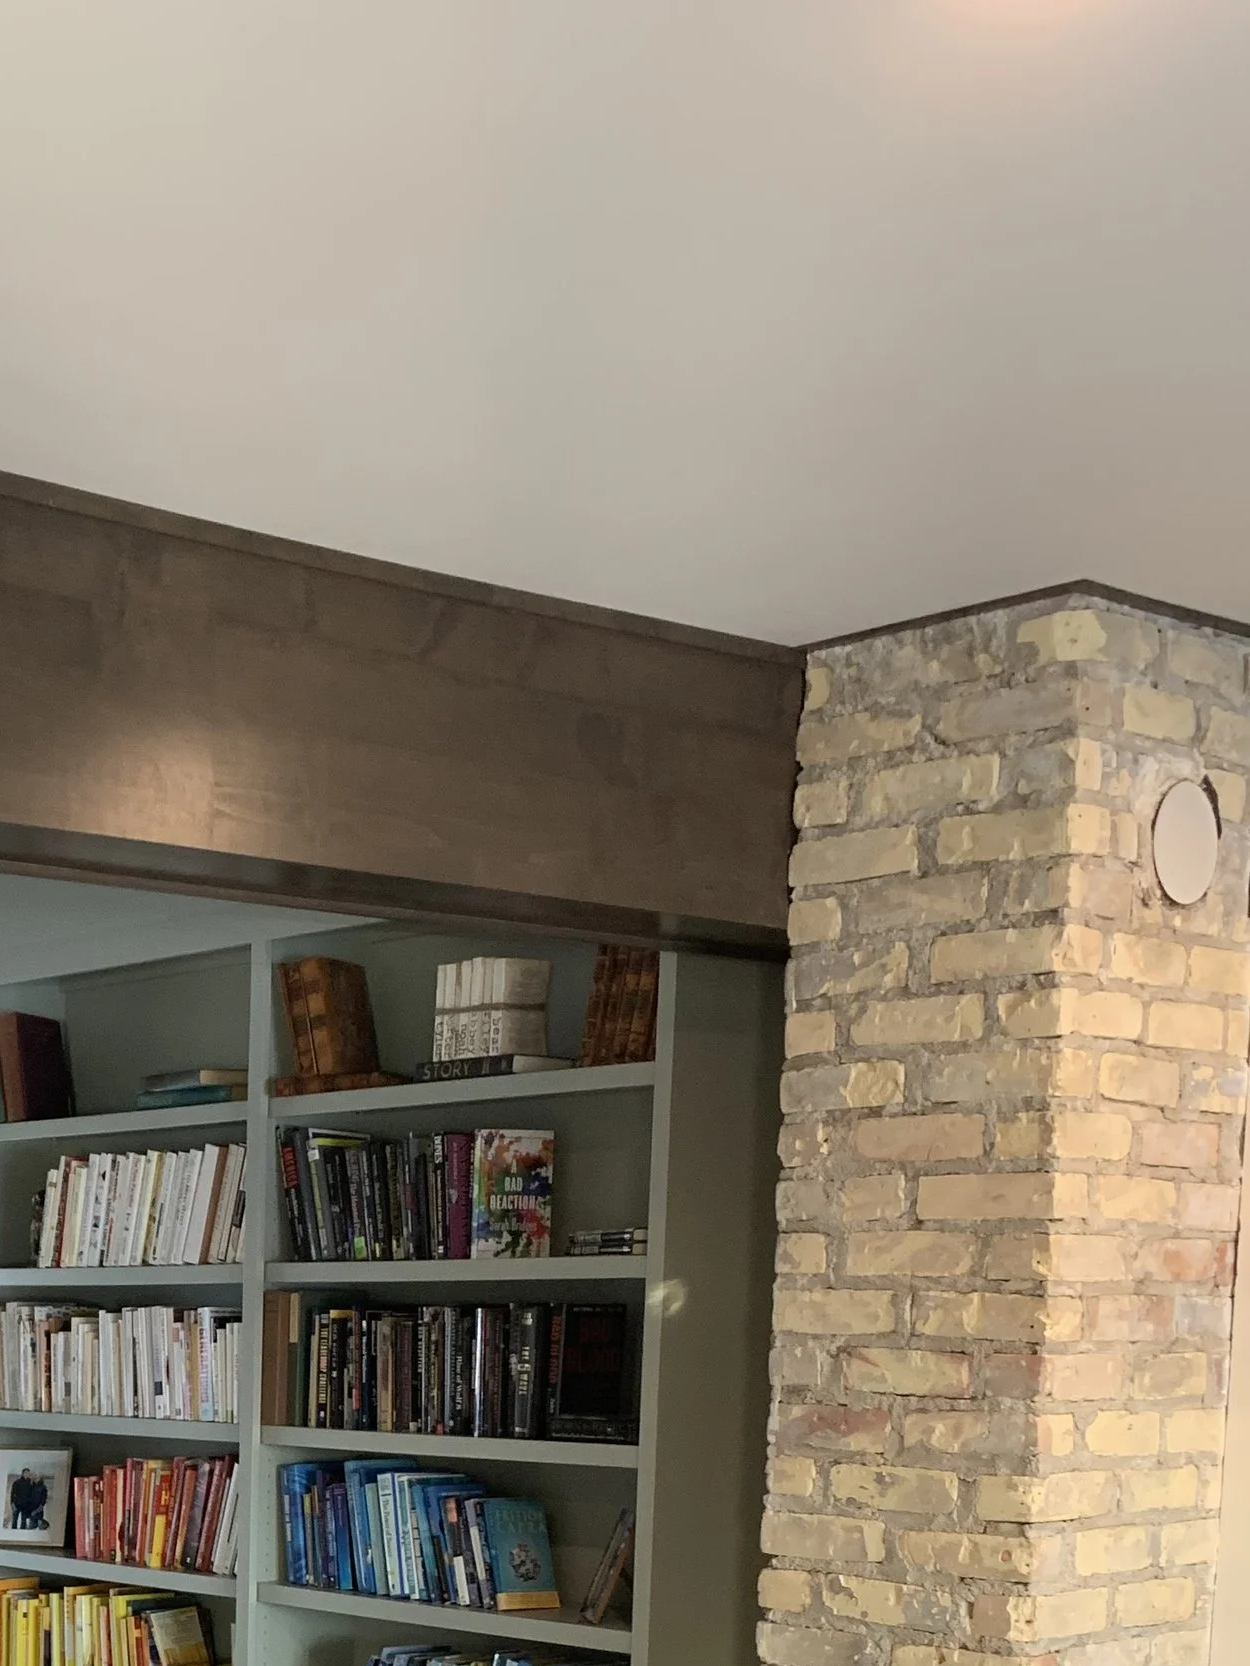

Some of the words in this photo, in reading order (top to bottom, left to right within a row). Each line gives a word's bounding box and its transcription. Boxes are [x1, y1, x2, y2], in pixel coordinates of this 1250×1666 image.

[422, 1062, 470, 1080] STORY
[505, 1177, 523, 1192] BAD
[490, 1195, 536, 1210] REACTION
